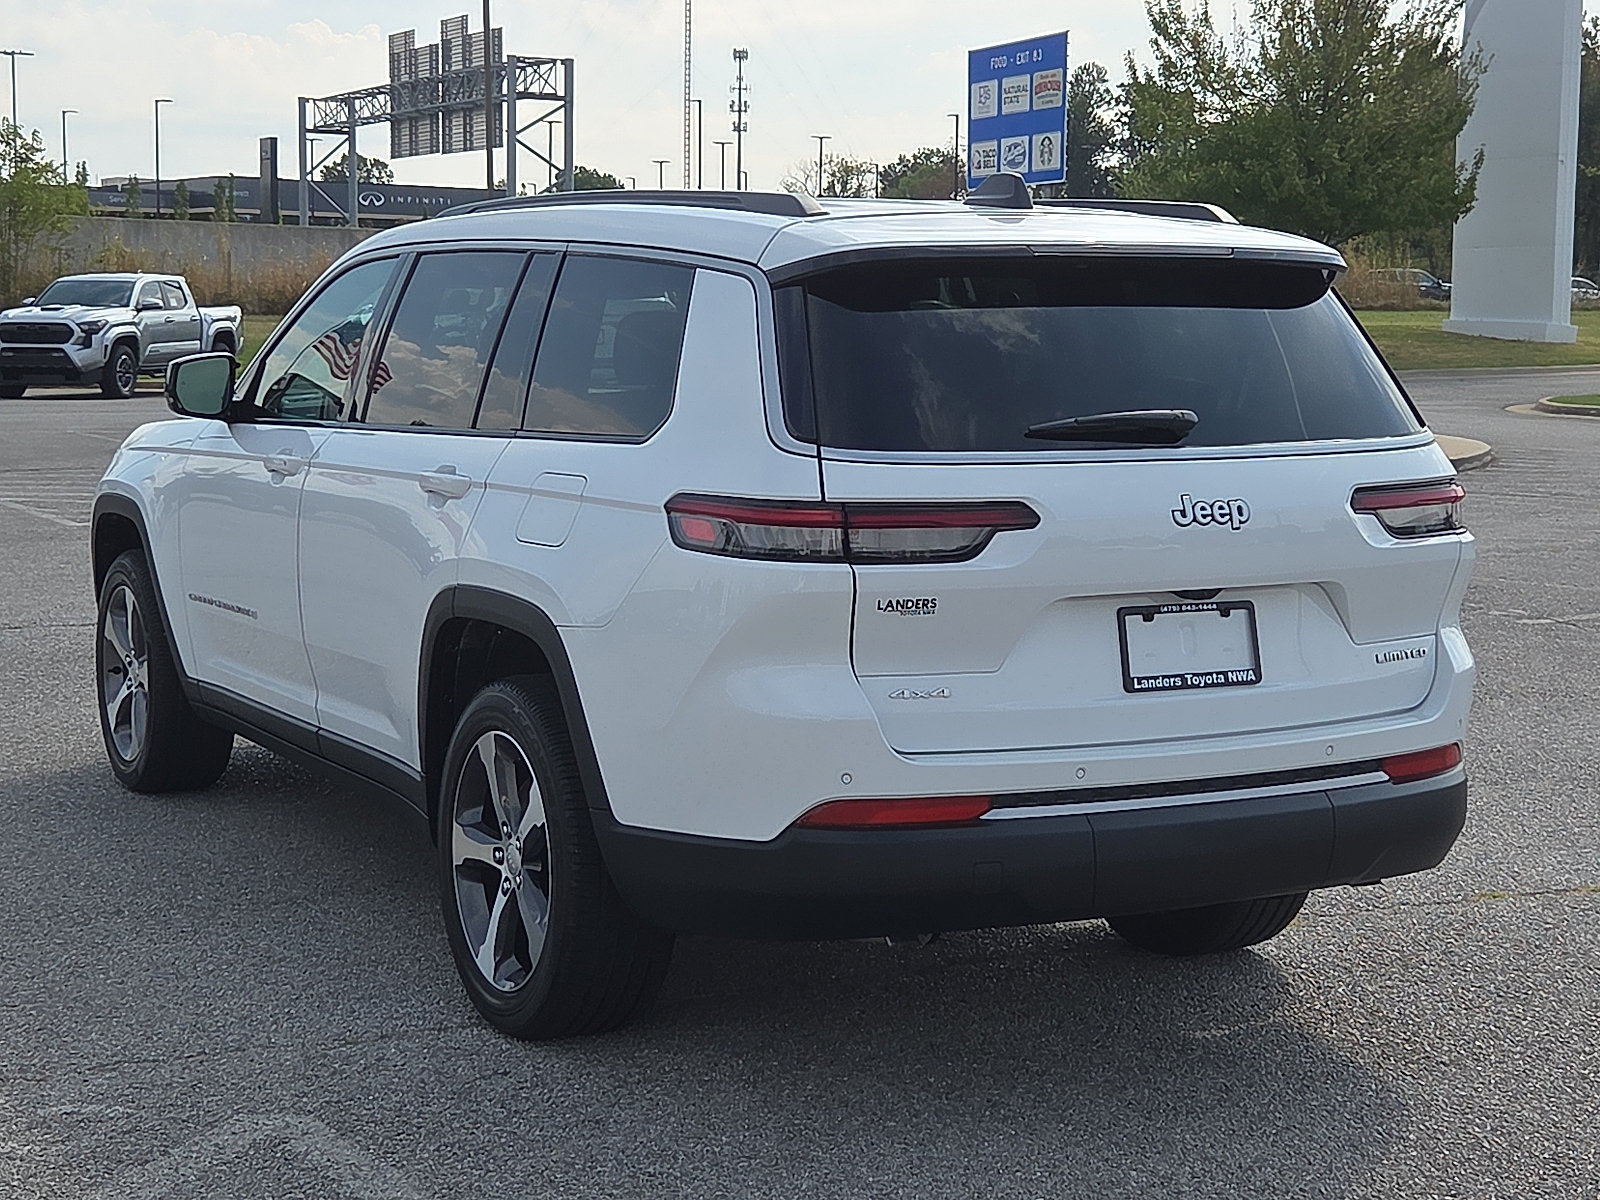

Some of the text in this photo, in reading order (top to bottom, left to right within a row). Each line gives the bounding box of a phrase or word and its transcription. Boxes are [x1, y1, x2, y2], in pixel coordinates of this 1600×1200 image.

[990, 55, 1007, 69] FOOD
[1016, 51, 1029, 65] EXIT
[1003, 84, 1028, 95] NATURAL
[1003, 95, 1020, 105] STATE
[983, 149, 996, 158] TACO
[983, 159, 995, 169] BELL
[390, 196, 451, 205] INFINITI
[1171, 494, 1250, 530] Jeep
[877, 598, 937, 612] LANDERS
[1375, 648, 1426, 664] LIMITED
[1133, 669, 1256, 689] Landers Toyota NWA
